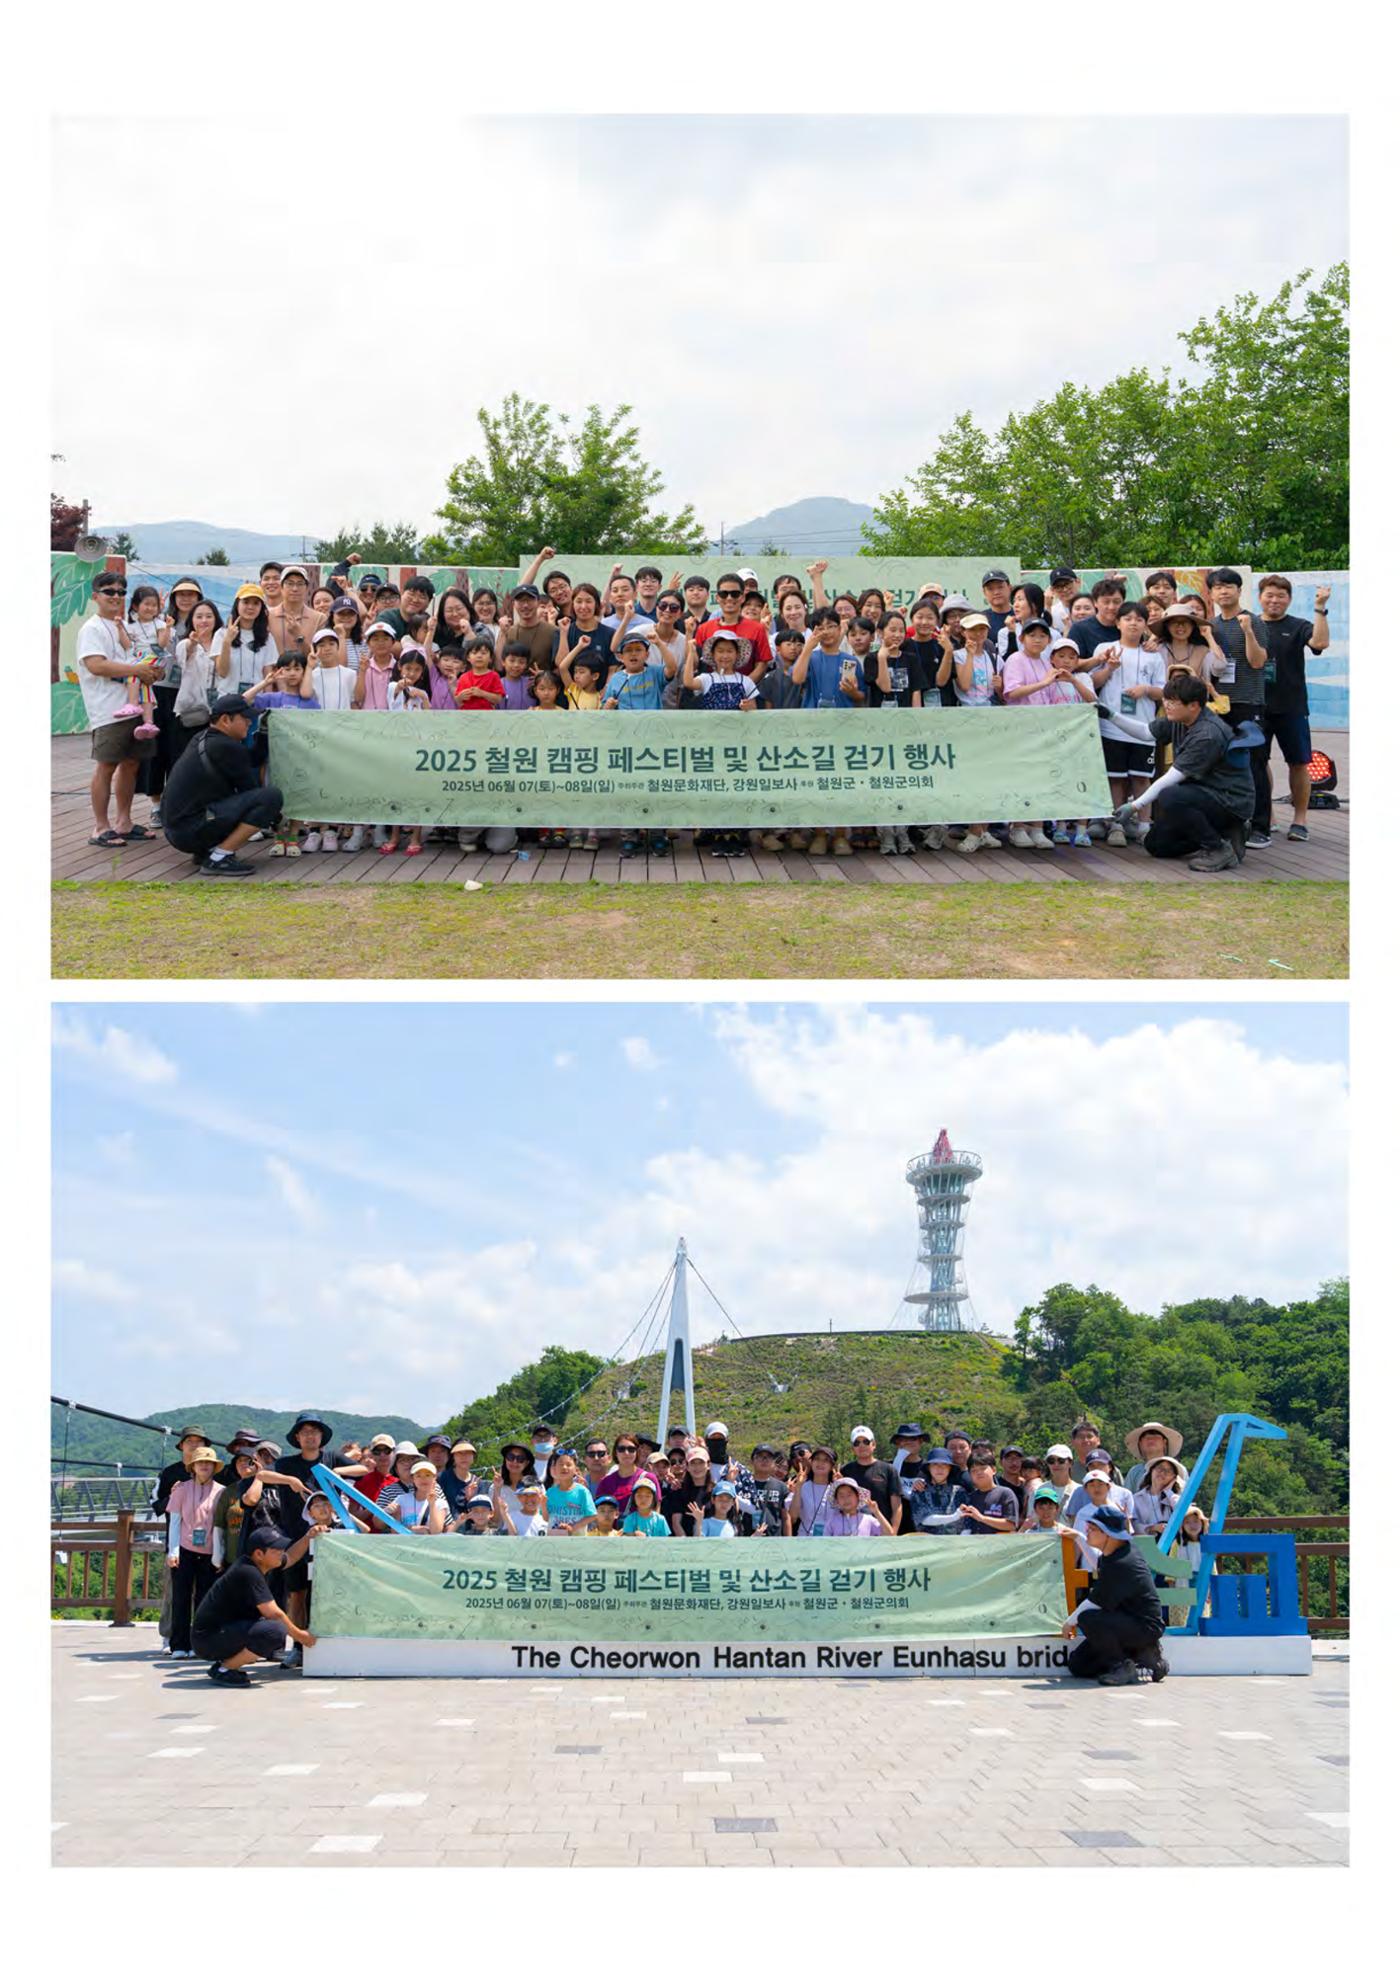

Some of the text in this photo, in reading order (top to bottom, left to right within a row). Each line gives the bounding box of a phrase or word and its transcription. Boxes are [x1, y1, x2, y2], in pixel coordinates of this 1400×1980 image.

[415, 743, 957, 774] 2025 철원 캠핑 페스티벌 및 산소길 걷기 행사
[442, 779, 485, 793] 2025년
[487, 779, 516, 793] 06월
[518, 778, 616, 794] 07(토)~08일(일)
[647, 777, 730, 793] 철원문화재단,
[732, 777, 798, 792] 강원일보사
[816, 776, 856, 790] 철원군
[868, 775, 934, 790] 철원군의회
[442, 1567, 931, 1593] 2025 철원 캠핑 페스티벌 및 산소길 걷기 행사
[465, 1597, 504, 1610] 2025년
[506, 1597, 532, 1610] 06월
[534, 1597, 621, 1611] 07(토)~08일(일)
[649, 1597, 725, 1611] 철원문화재단,
[726, 1597, 787, 1611] 강원일보사
[802, 1597, 839, 1611] 철원군
[850, 1596, 909, 1610] 철원군의회
[511, 1645, 1070, 1669] The Cheorwon Hantan River Eunhasu brid
